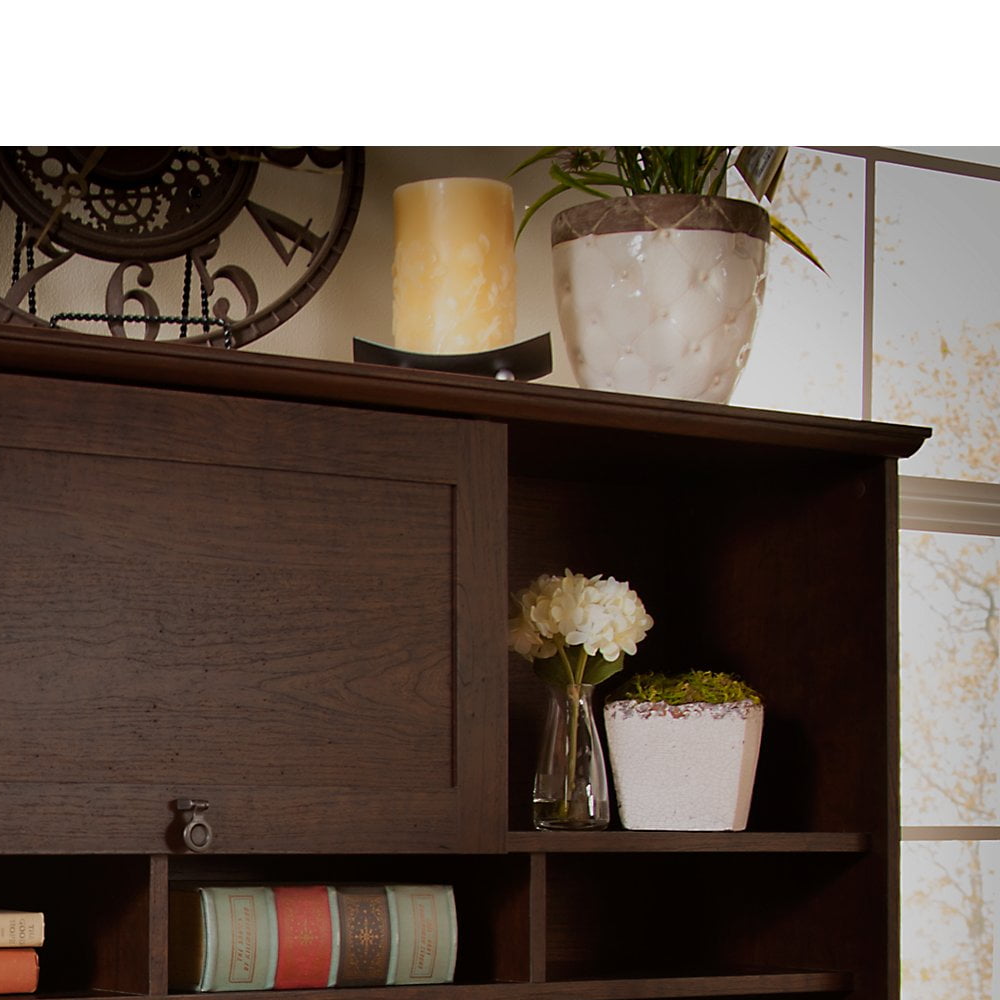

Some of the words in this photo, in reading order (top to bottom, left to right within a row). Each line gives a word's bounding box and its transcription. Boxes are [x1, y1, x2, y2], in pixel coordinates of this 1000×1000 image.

[245, 200, 330, 268] 4
[104, 259, 162, 341] 6
[191, 237, 259, 324] 5
